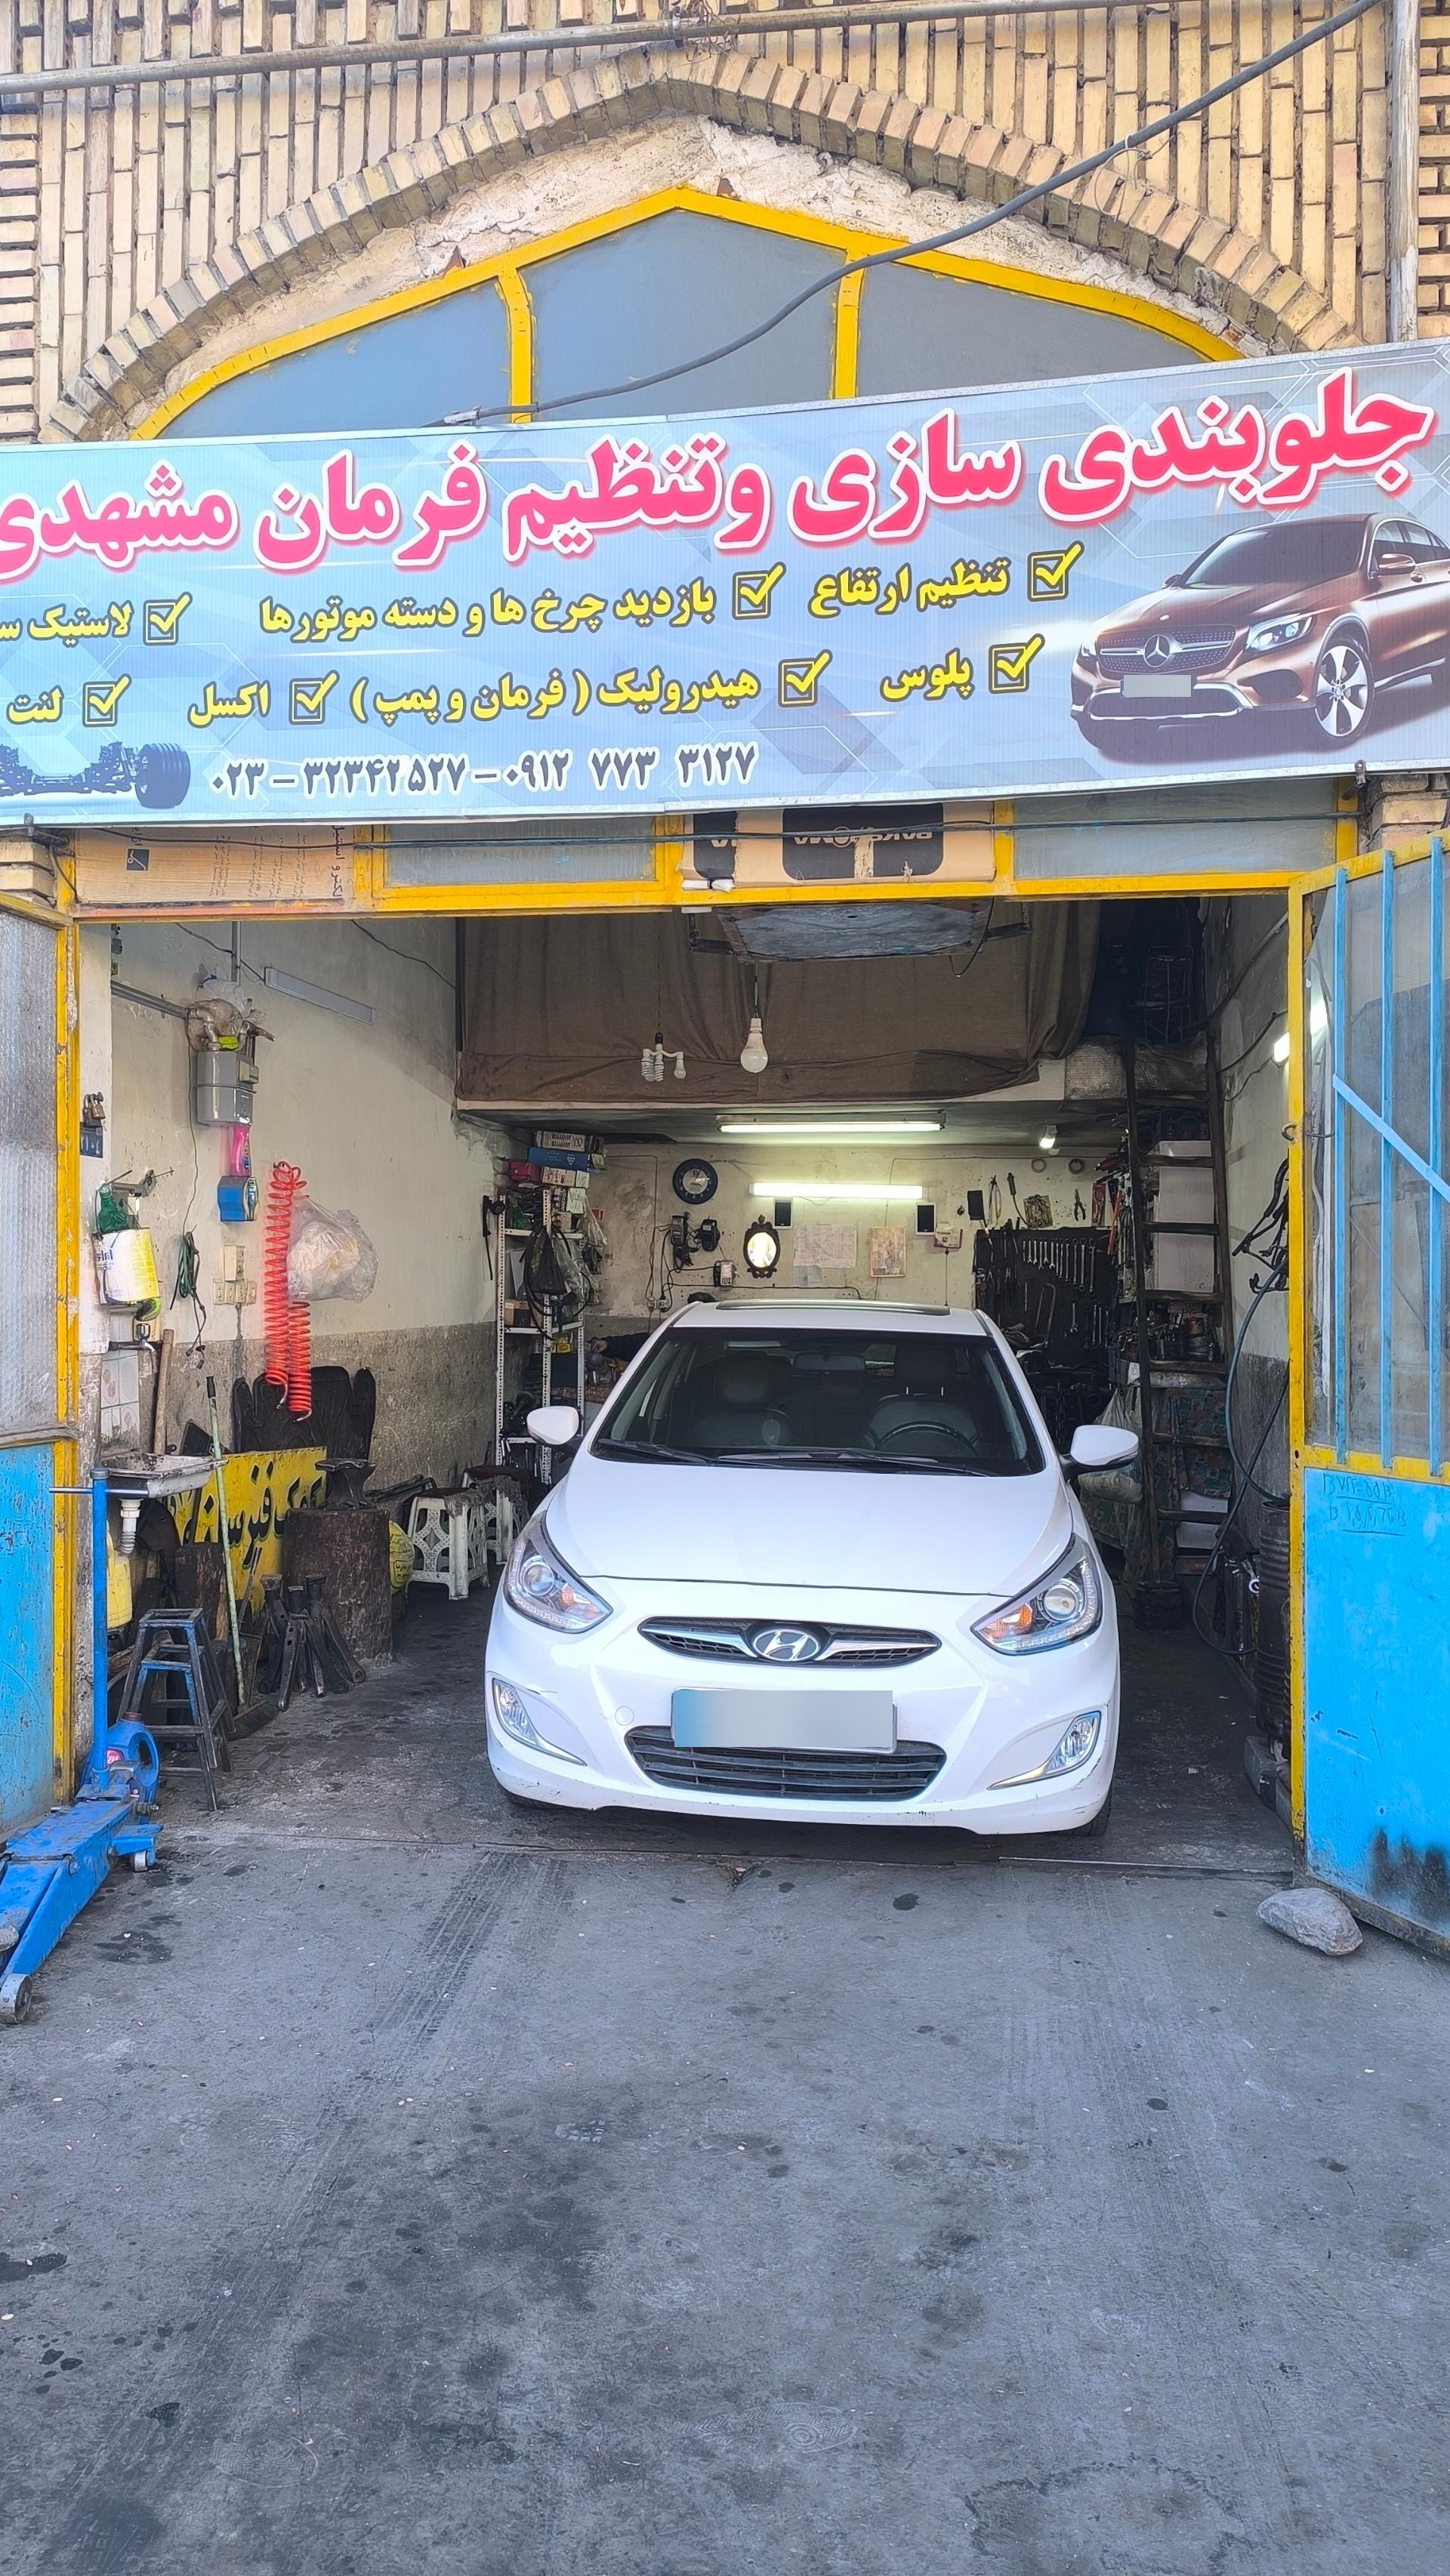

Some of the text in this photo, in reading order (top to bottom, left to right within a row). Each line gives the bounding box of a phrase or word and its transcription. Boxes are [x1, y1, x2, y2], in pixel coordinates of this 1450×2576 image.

[1043, 371, 1430, 516] جلوبندی
[792, 416, 1015, 538] سازی
[0, 464, 233, 574] مشهدی
[257, 443, 483, 565] فرمان
[491, 591, 525, 624] ها
[613, 581, 716, 626] بازدید
[809, 557, 1009, 618] تنظیم ارتفاع
[28, 602, 132, 646] لاستیک
[384, 596, 456, 627] دسته
[466, 605, 484, 637] و
[532, 590, 606, 633] چرخ
[598, 667, 759, 713] هیدرولیک
[881, 651, 972, 701] پلوس
[8, 687, 62, 723] لنت
[189, 683, 270, 726] اکسل
[449, 692, 464, 721] و
[591, 750, 656, 787] ۷۷۳
[677, 746, 756, 784] ۳۱۲۷
